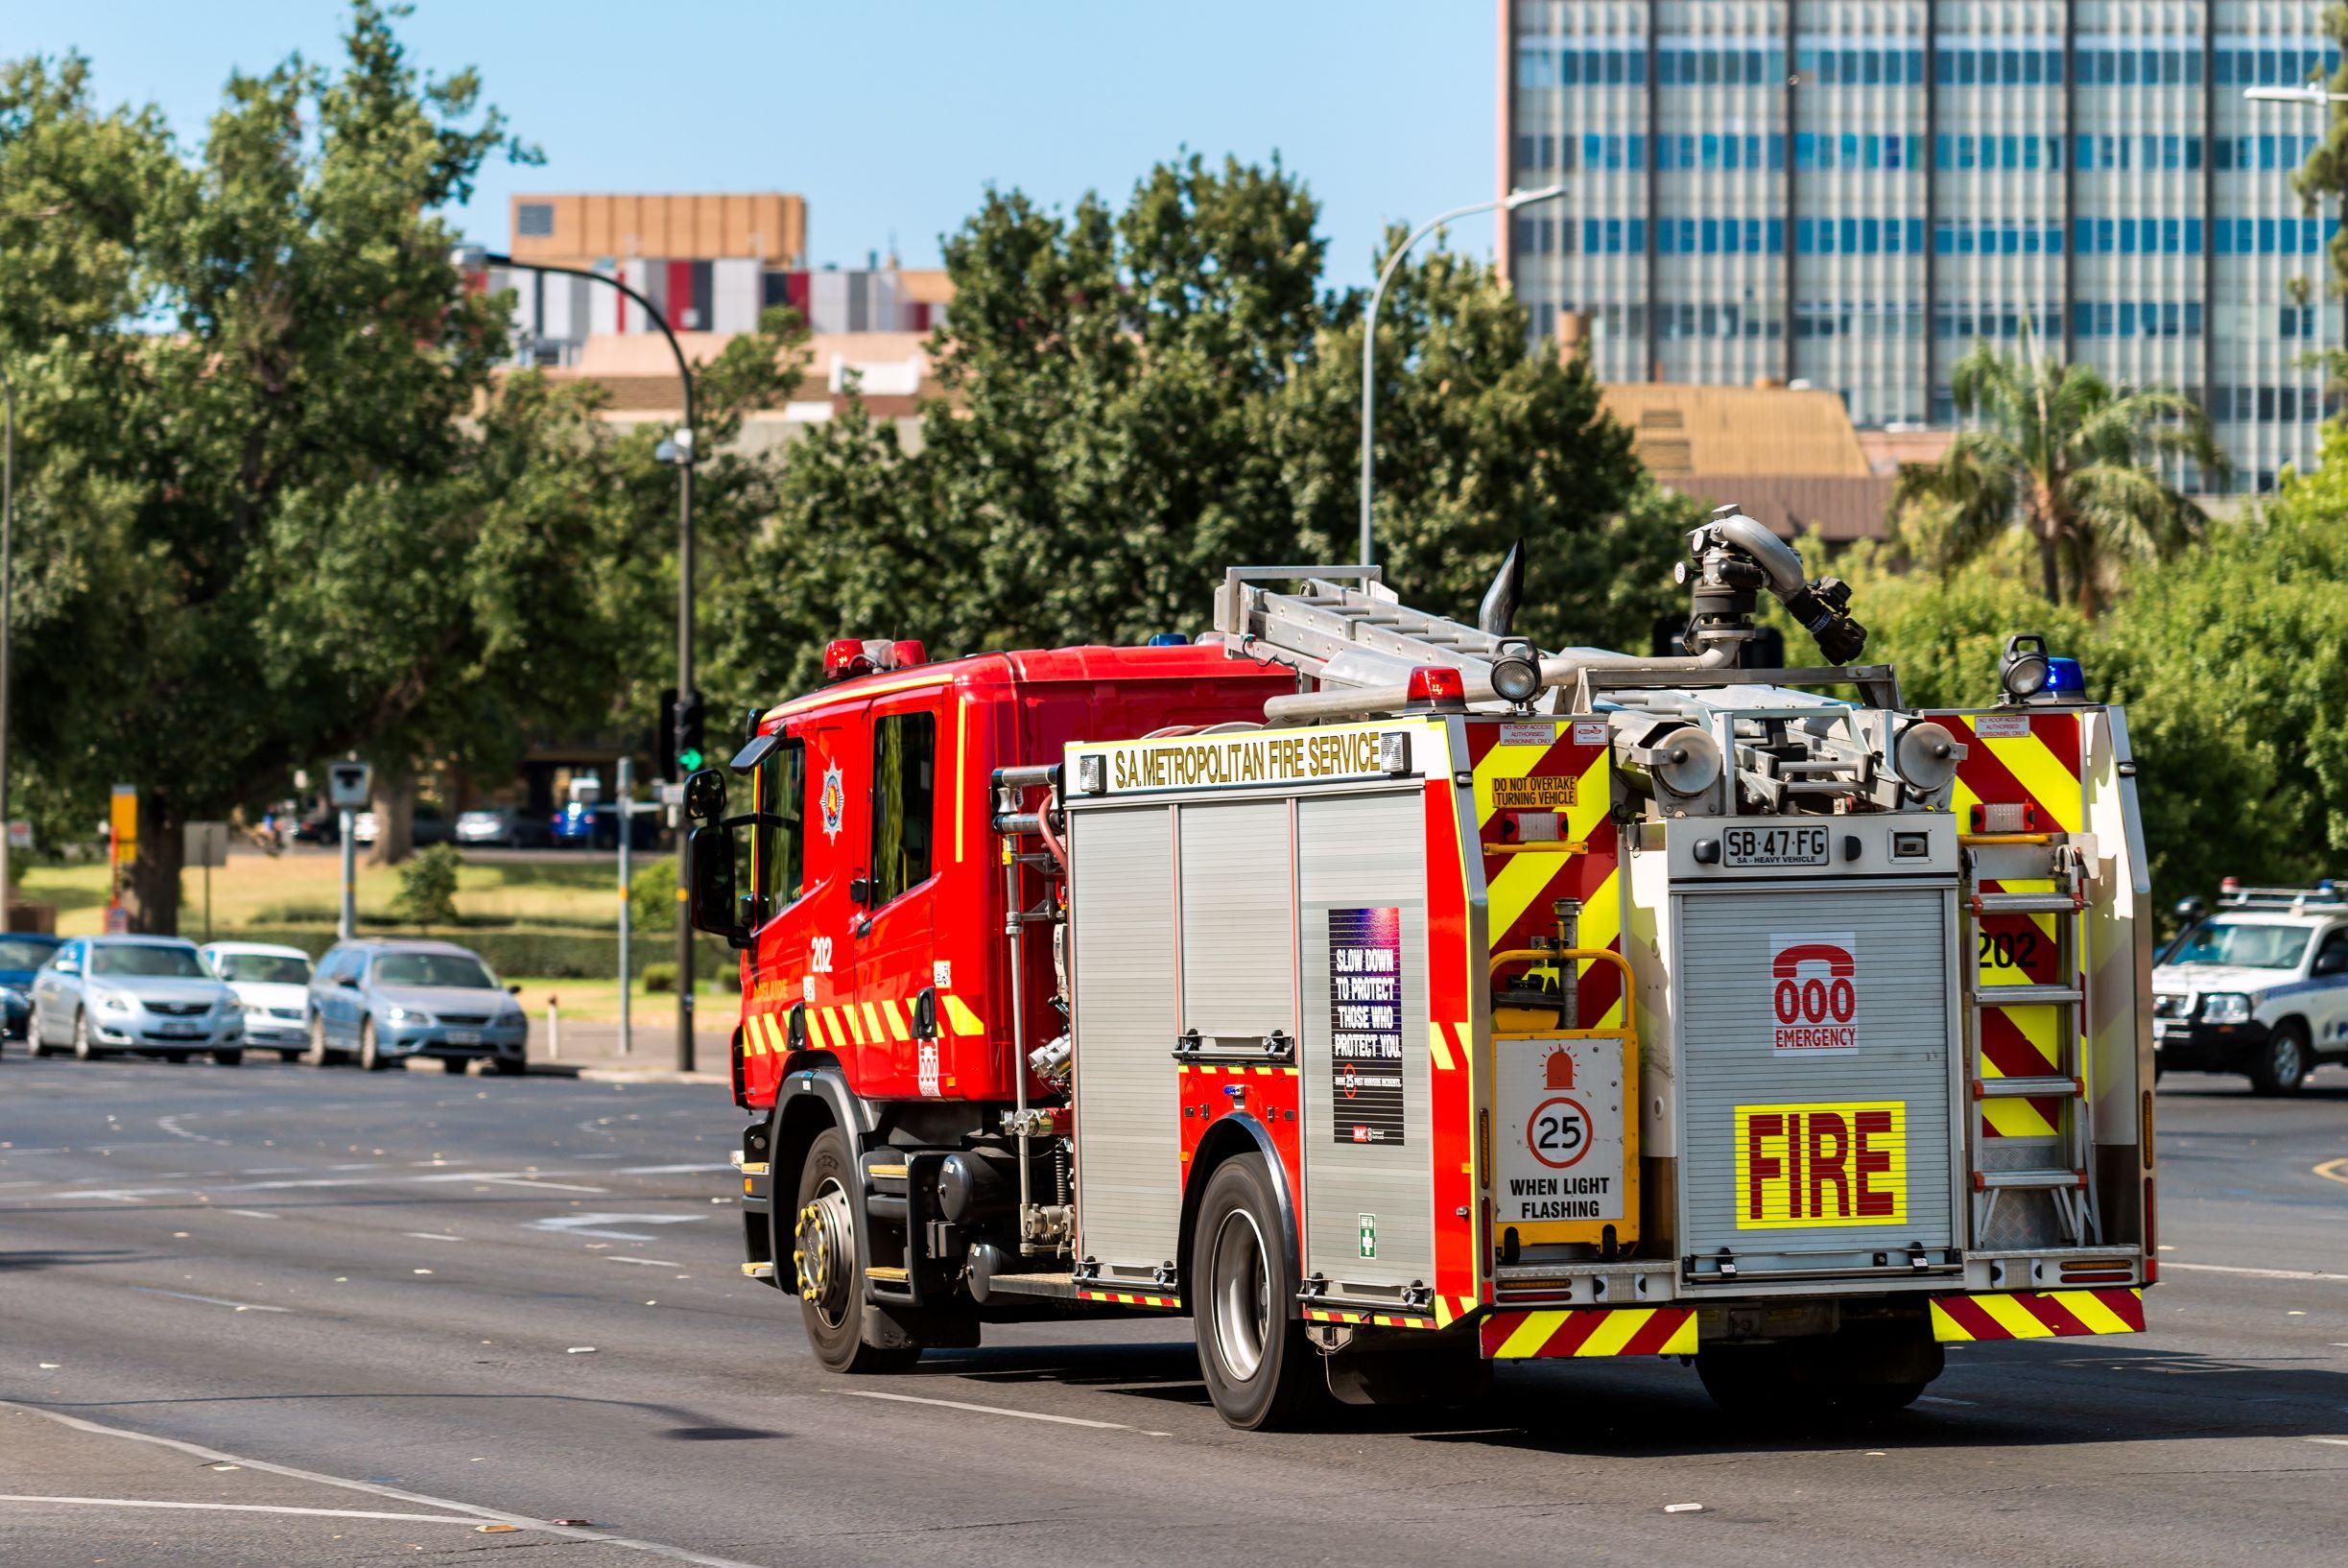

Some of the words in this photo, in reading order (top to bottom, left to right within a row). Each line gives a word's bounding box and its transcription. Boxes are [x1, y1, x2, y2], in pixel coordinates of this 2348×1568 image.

[1269, 739, 1304, 778] FIRE
[1309, 732, 1380, 776] SERVICE
[1494, 777, 1506, 792] DO
[1509, 777, 1528, 792] NOT
[1530, 776, 1576, 792] OVERTAKE
[1497, 792, 1535, 805] TURNING
[1538, 791, 1575, 805] VEHICLE
[811, 936, 834, 973] 202
[1336, 948, 1364, 972] SLOW
[1365, 948, 1394, 972] DOWN
[1979, 931, 2037, 968] 202
[1336, 977, 1349, 1000] TO
[1351, 977, 1395, 1000] PROTECT
[1774, 977, 1855, 1025] 000
[1338, 1005, 1369, 1029] THOSE
[1371, 1005, 1393, 1029] WHO
[1335, 1033, 1378, 1057] PROTECT
[1379, 1033, 1401, 1057] YOU.
[1775, 1027, 1856, 1048] EMERGENCY
[1539, 1116, 1581, 1149] 25
[1749, 1110, 1894, 1220] FIRE
[1509, 1178, 1557, 1196] WHEN
[1564, 1177, 1609, 1195] LIGHT
[1522, 1200, 1600, 1219] FLASHING
